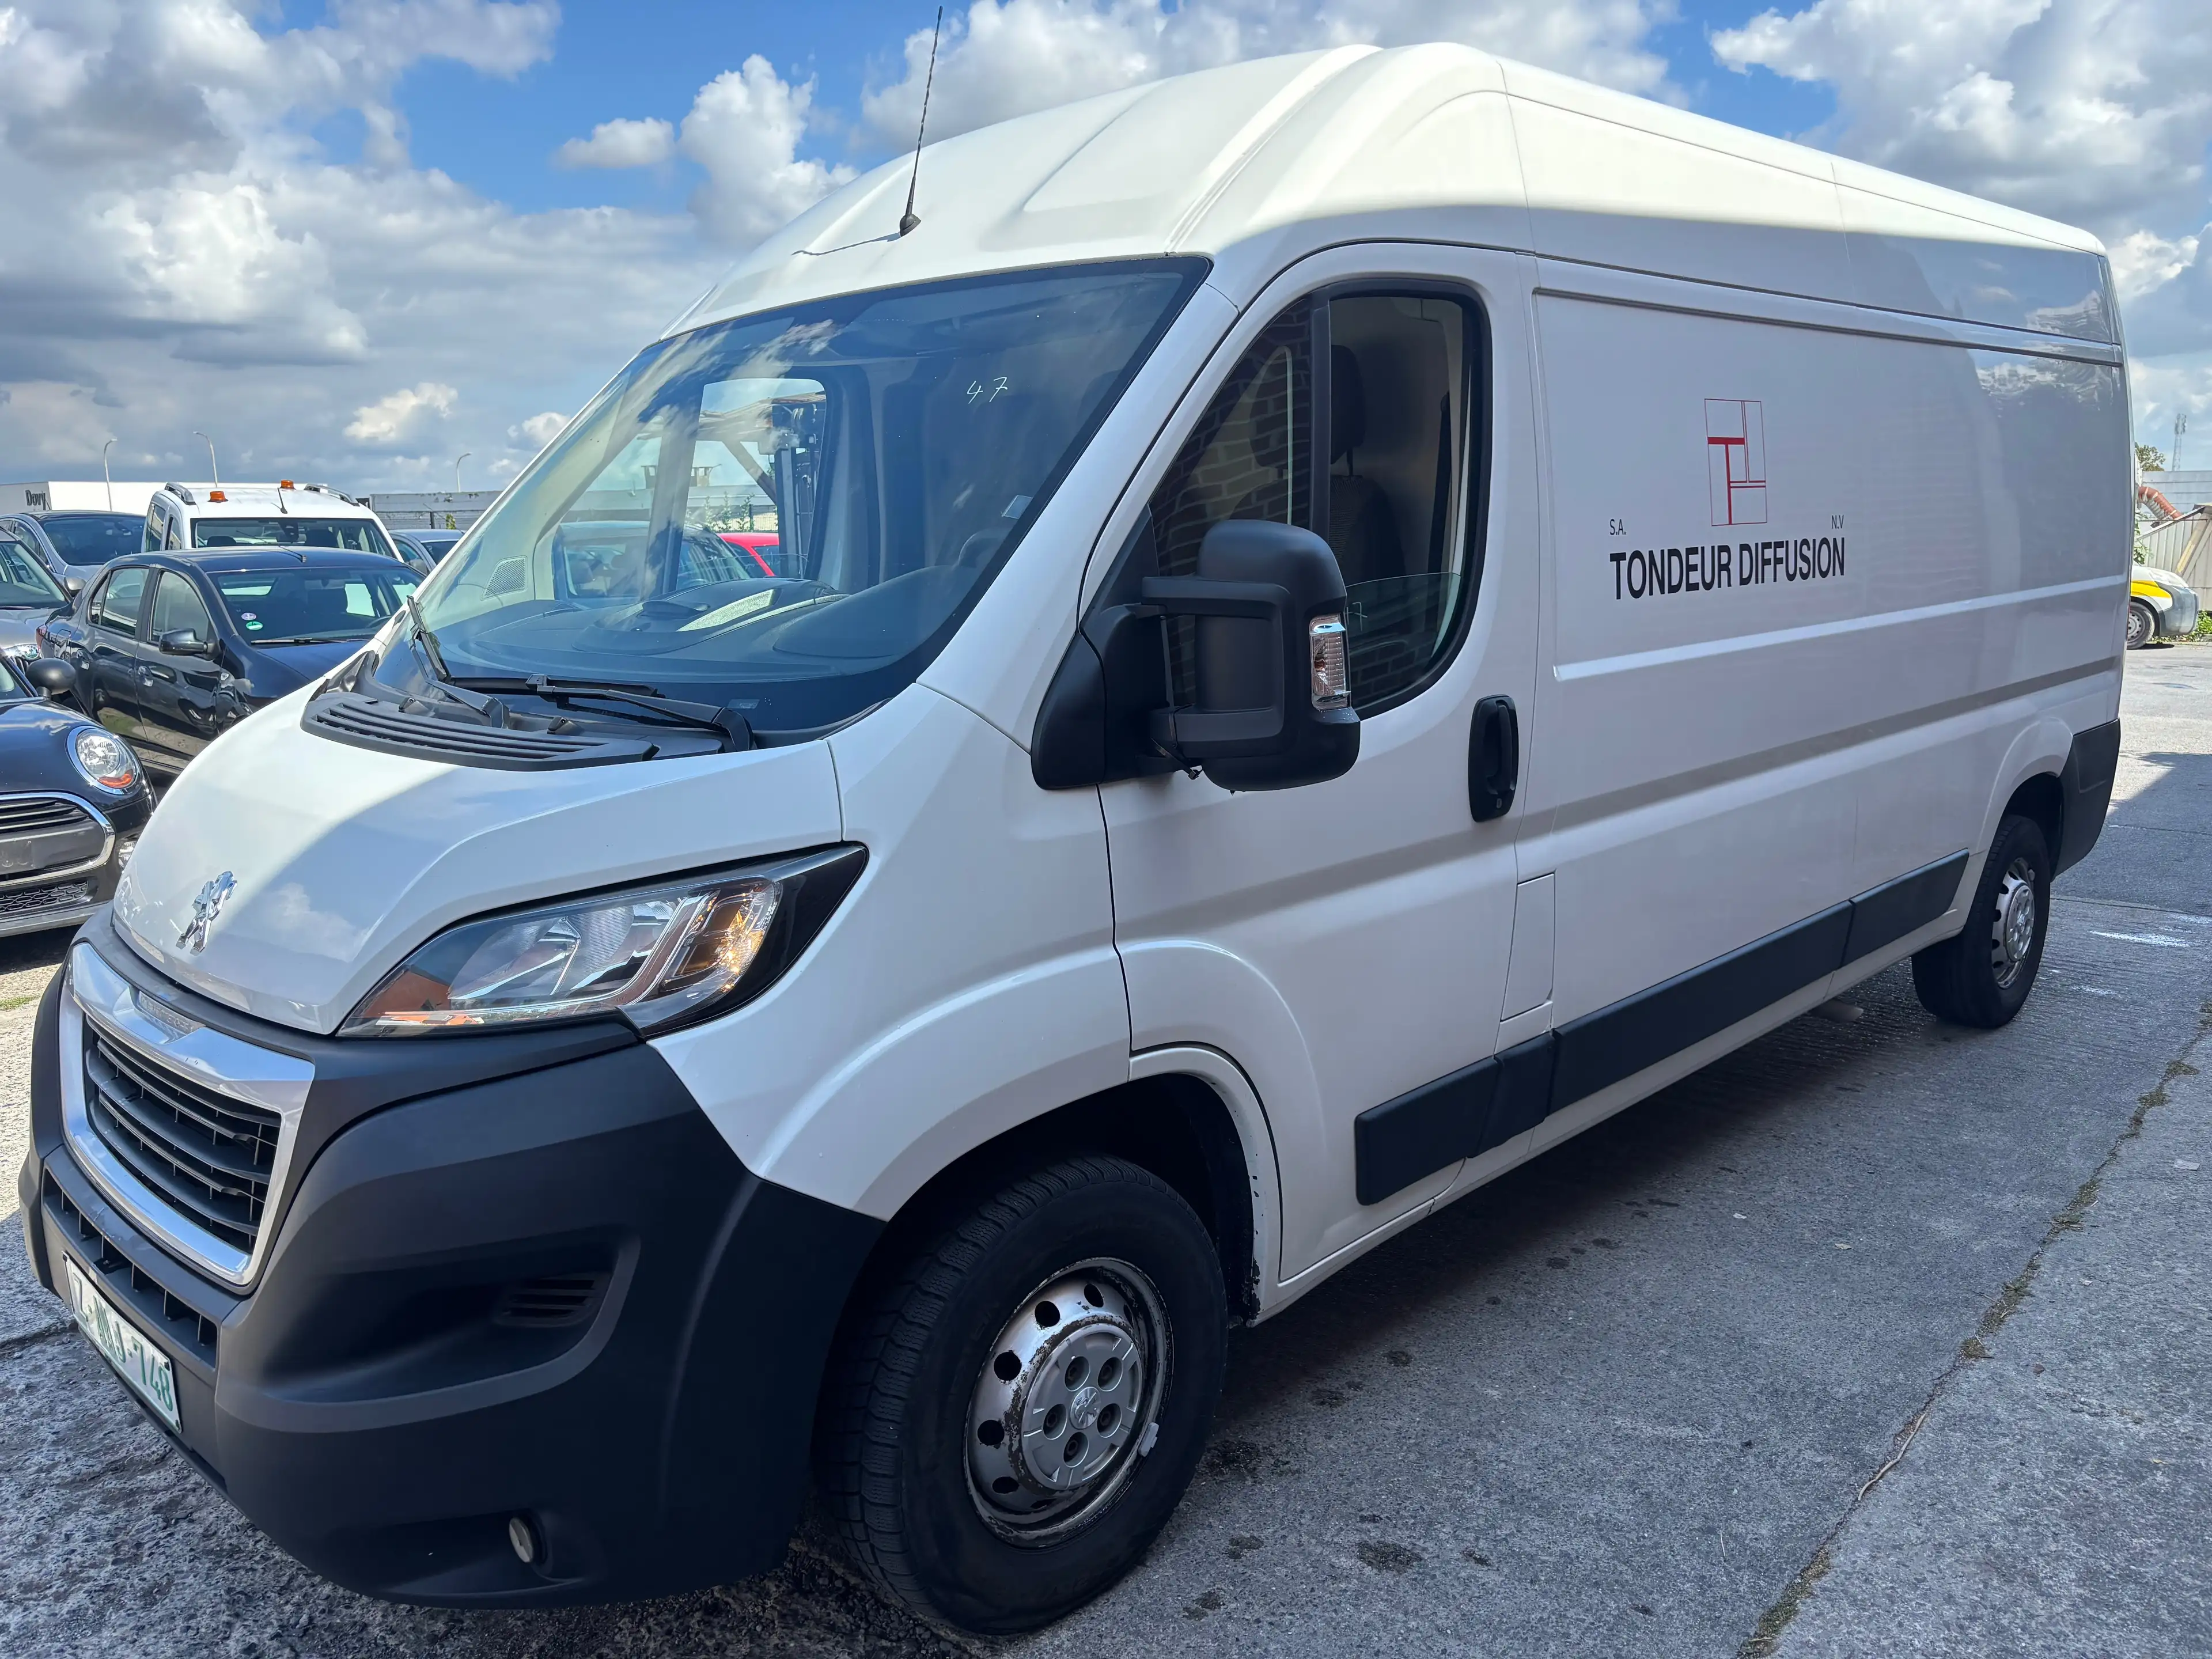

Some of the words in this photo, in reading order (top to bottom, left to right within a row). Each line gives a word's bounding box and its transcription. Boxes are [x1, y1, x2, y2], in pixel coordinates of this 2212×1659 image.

[967, 376, 1008, 404] 47
[25, 490, 46, 510] Dovy
[1609, 518, 1627, 536] S.A.
[1609, 544, 1732, 600] TONDEUR
[1738, 537, 1846, 586] DIFFUSION
